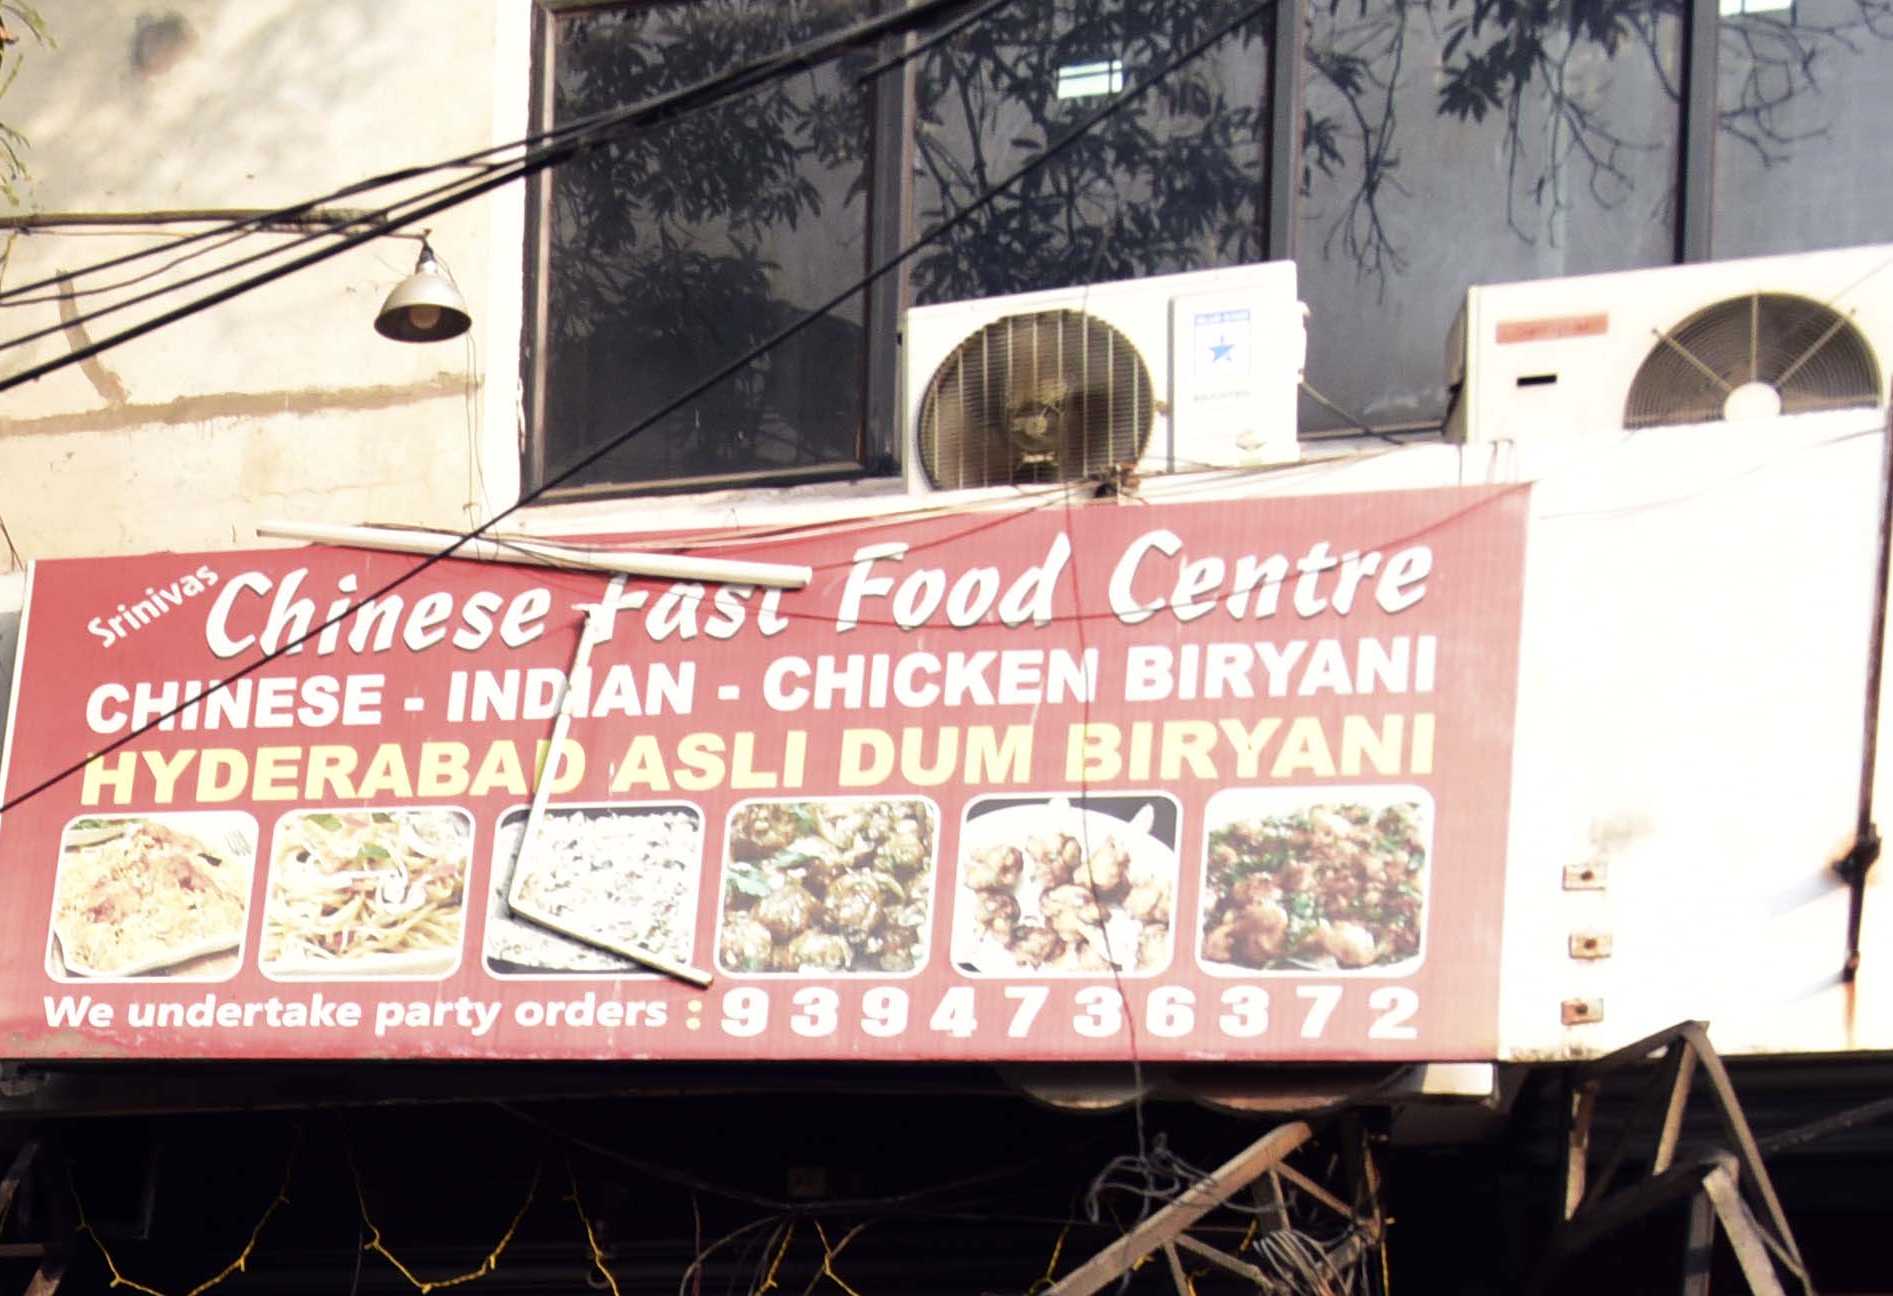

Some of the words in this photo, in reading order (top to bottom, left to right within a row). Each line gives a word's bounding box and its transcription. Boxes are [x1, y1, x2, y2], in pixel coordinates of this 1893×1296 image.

[87, 565, 219, 649] Srinivas
[205, 567, 552, 659] Chinese
[835, 532, 1071, 633] Food
[1108, 530, 1434, 624] Centre
[85, 674, 385, 734] CHINESE
[447, 661, 696, 724] INDIAN
[763, 647, 1098, 712] CHICKEN
[1124, 635, 1437, 702] BIRYANI
[80, 740, 587, 806] HYDERABAD
[609, 730, 808, 795] ASLI
[838, 725, 1035, 787] DUM
[1064, 713, 1436, 785] BIRYANI
[43, 995, 114, 1029] We
[127, 992, 361, 1029] undertake
[374, 996, 501, 1036] party
[514, 992, 669, 1029] orders
